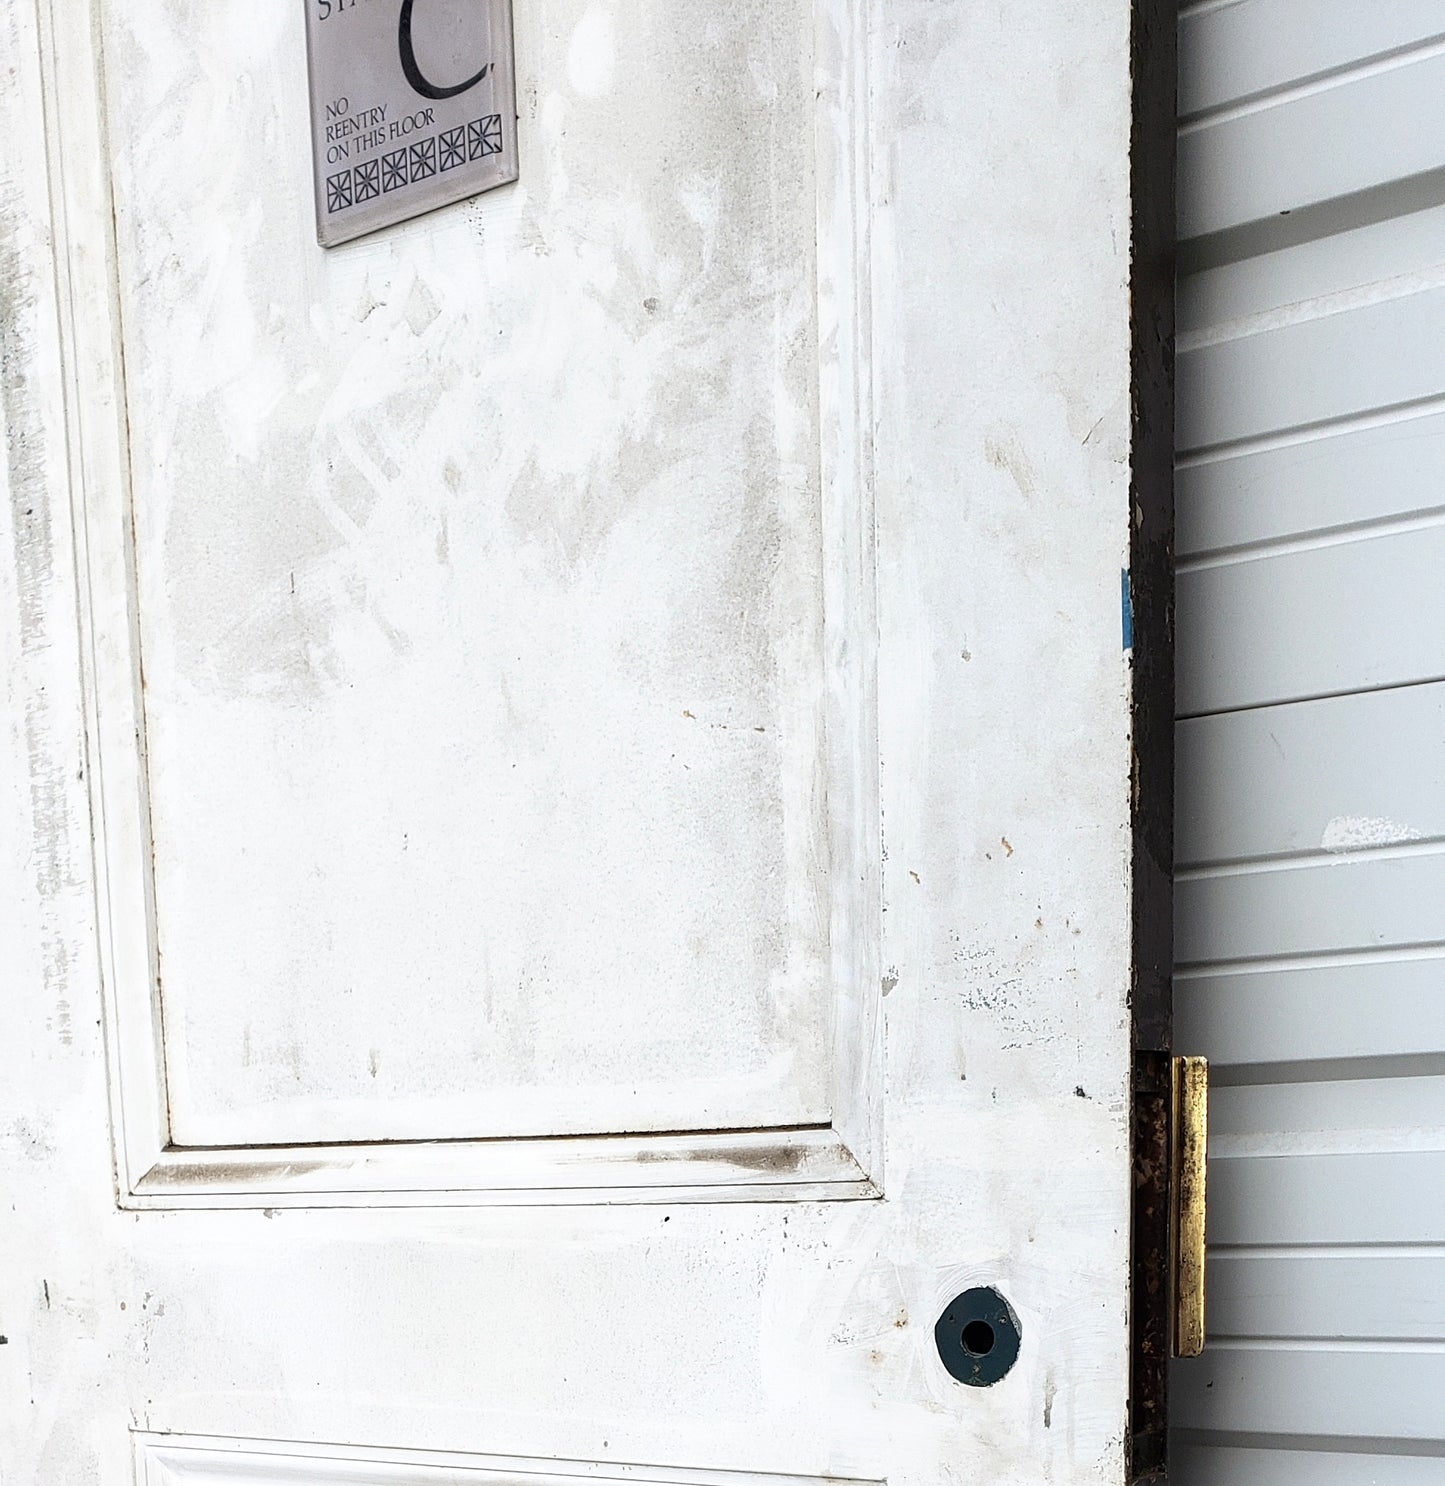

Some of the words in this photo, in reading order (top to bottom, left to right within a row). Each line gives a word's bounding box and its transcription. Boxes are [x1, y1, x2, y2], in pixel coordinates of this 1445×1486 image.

[397, 0, 495, 100] C
[325, 103, 388, 143] REENTRY
[326, 97, 349, 121] NO
[327, 141, 349, 164] ON
[353, 126, 386, 154] THIS
[389, 107, 436, 140] FLOOR
